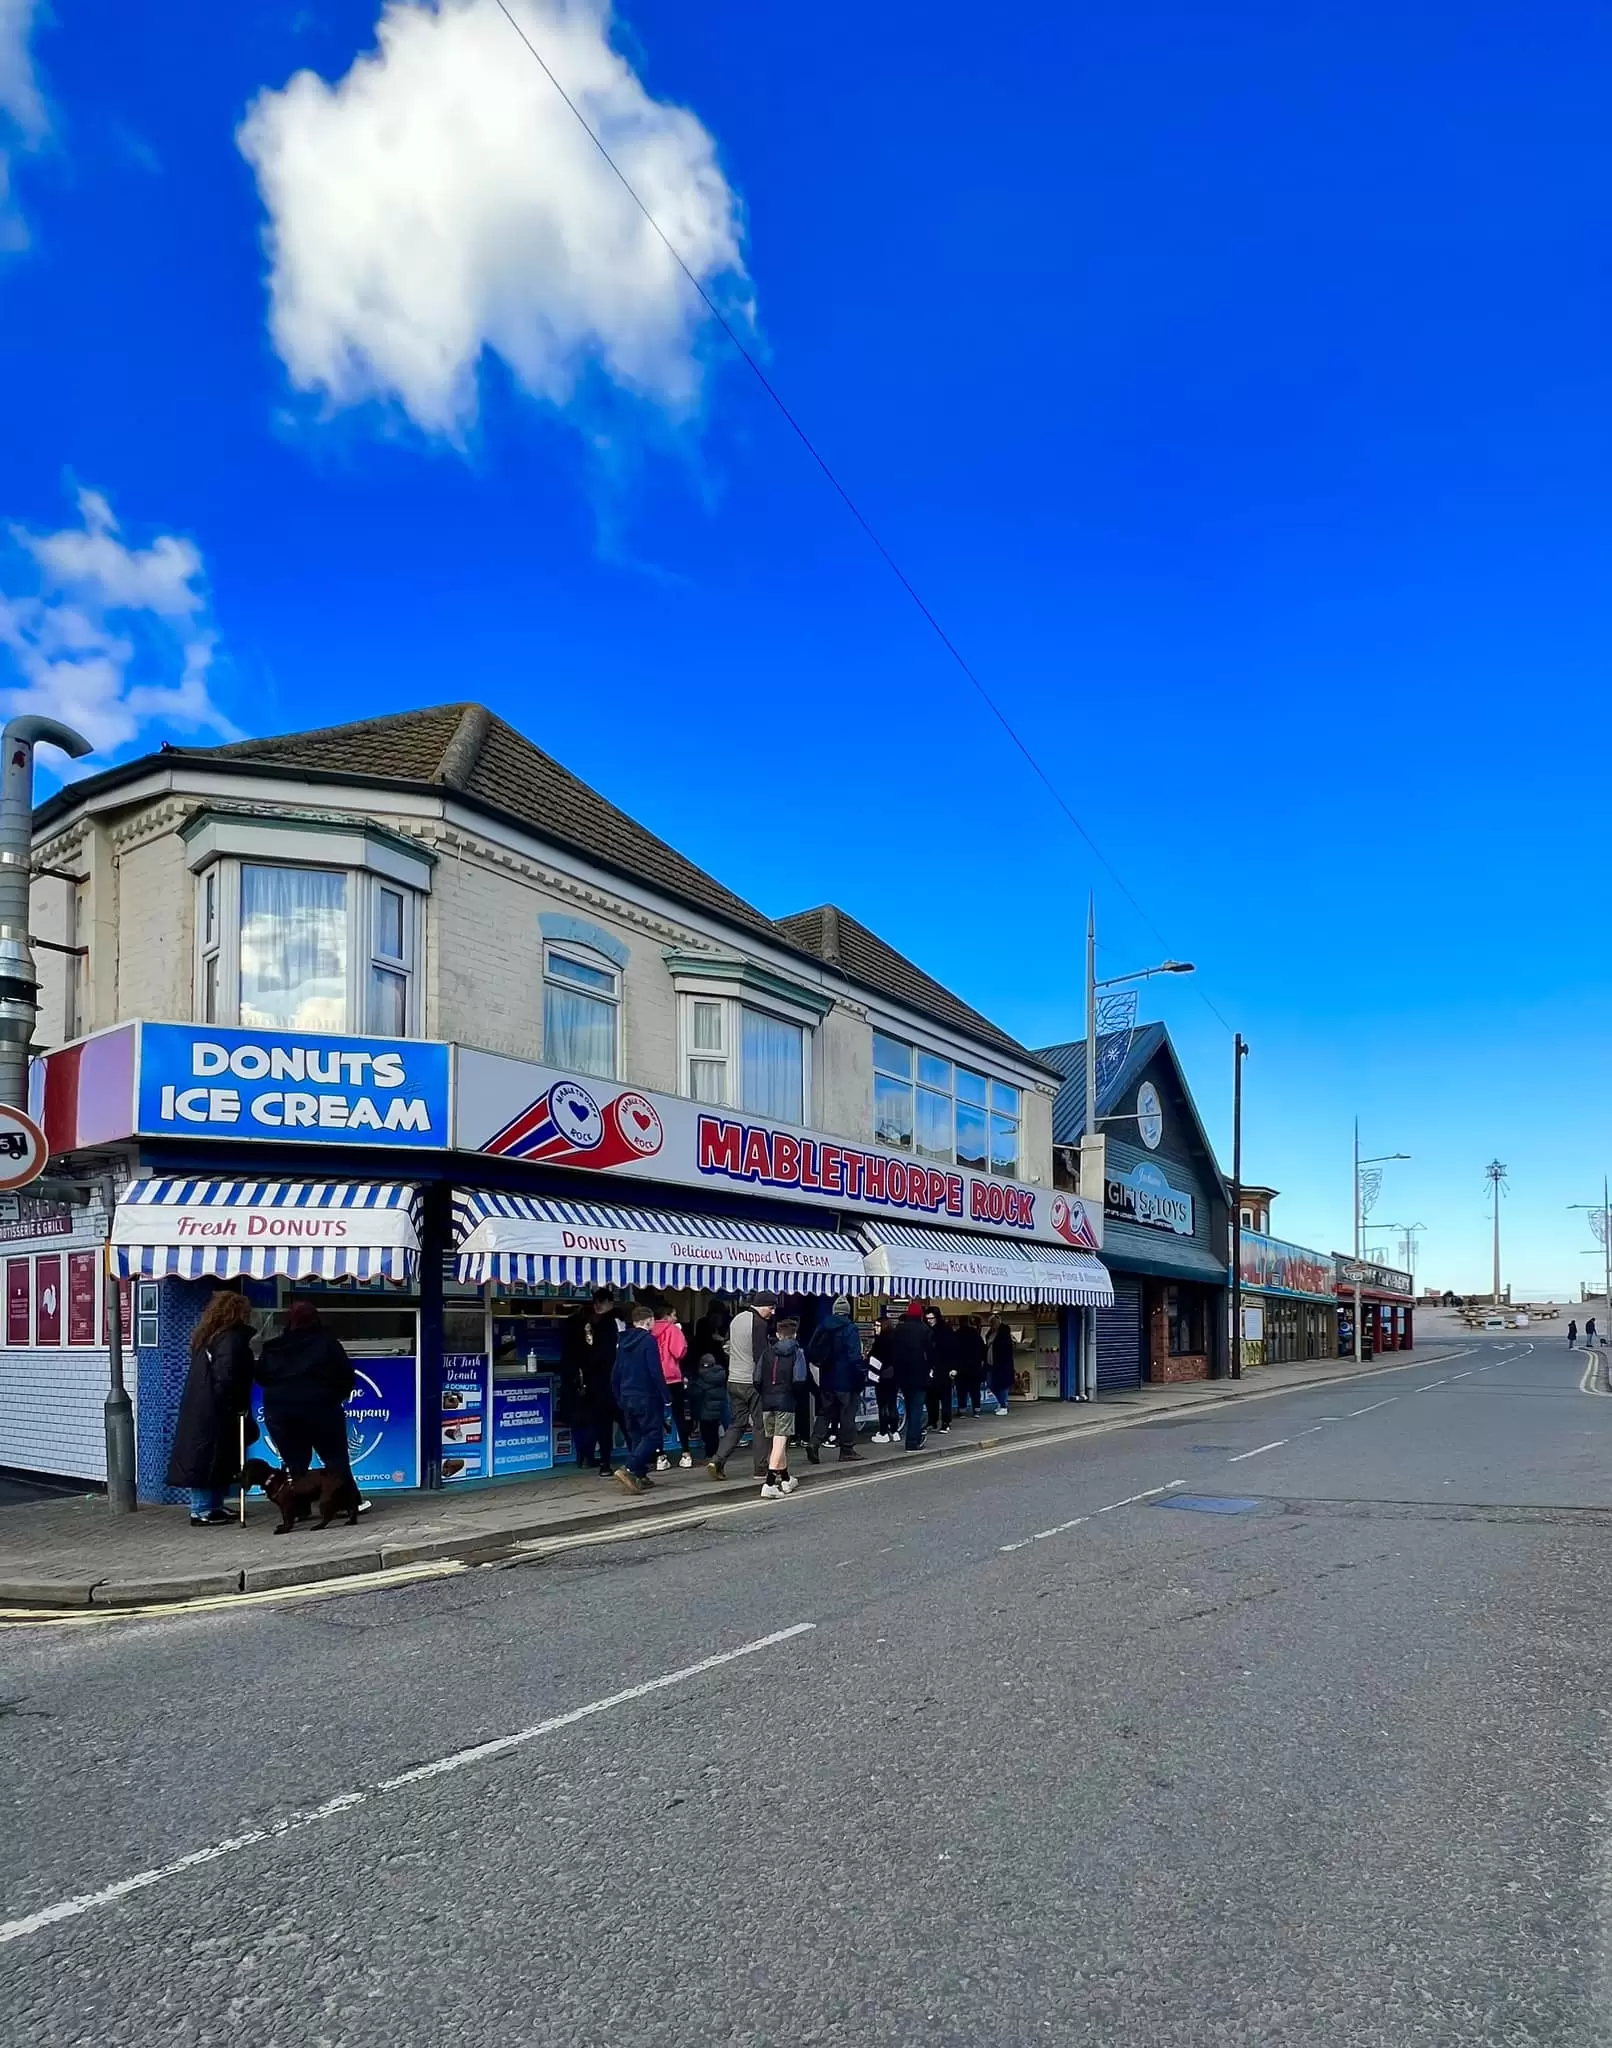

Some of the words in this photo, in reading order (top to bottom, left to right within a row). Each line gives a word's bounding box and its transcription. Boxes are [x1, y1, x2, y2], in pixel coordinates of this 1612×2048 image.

[191, 1041, 406, 1088] DONUTS
[160, 1085, 241, 1123] ICE
[250, 1091, 432, 1132] CREAM
[697, 1114, 963, 1216] MABLETHORPE
[970, 1178, 1036, 1230] ROCK
[1153, 1194, 1187, 1222] TOYS
[37, 1223, 42, 1234] &
[43, 1219, 64, 1233] GRILL
[177, 1216, 237, 1237] Fresh
[247, 1215, 347, 1237] DONUTS
[561, 1231, 627, 1253] DONUTS
[670, 1242, 723, 1260] Delicious
[726, 1246, 773, 1265] Whipped
[775, 1250, 793, 1265] ICE
[795, 1252, 831, 1267] CREAM
[949, 1260, 969, 1273] ROCK
[970, 1262, 976, 1273] &
[450, 1383, 477, 1391] DONUTS
[507, 1438, 525, 1446] COLD
